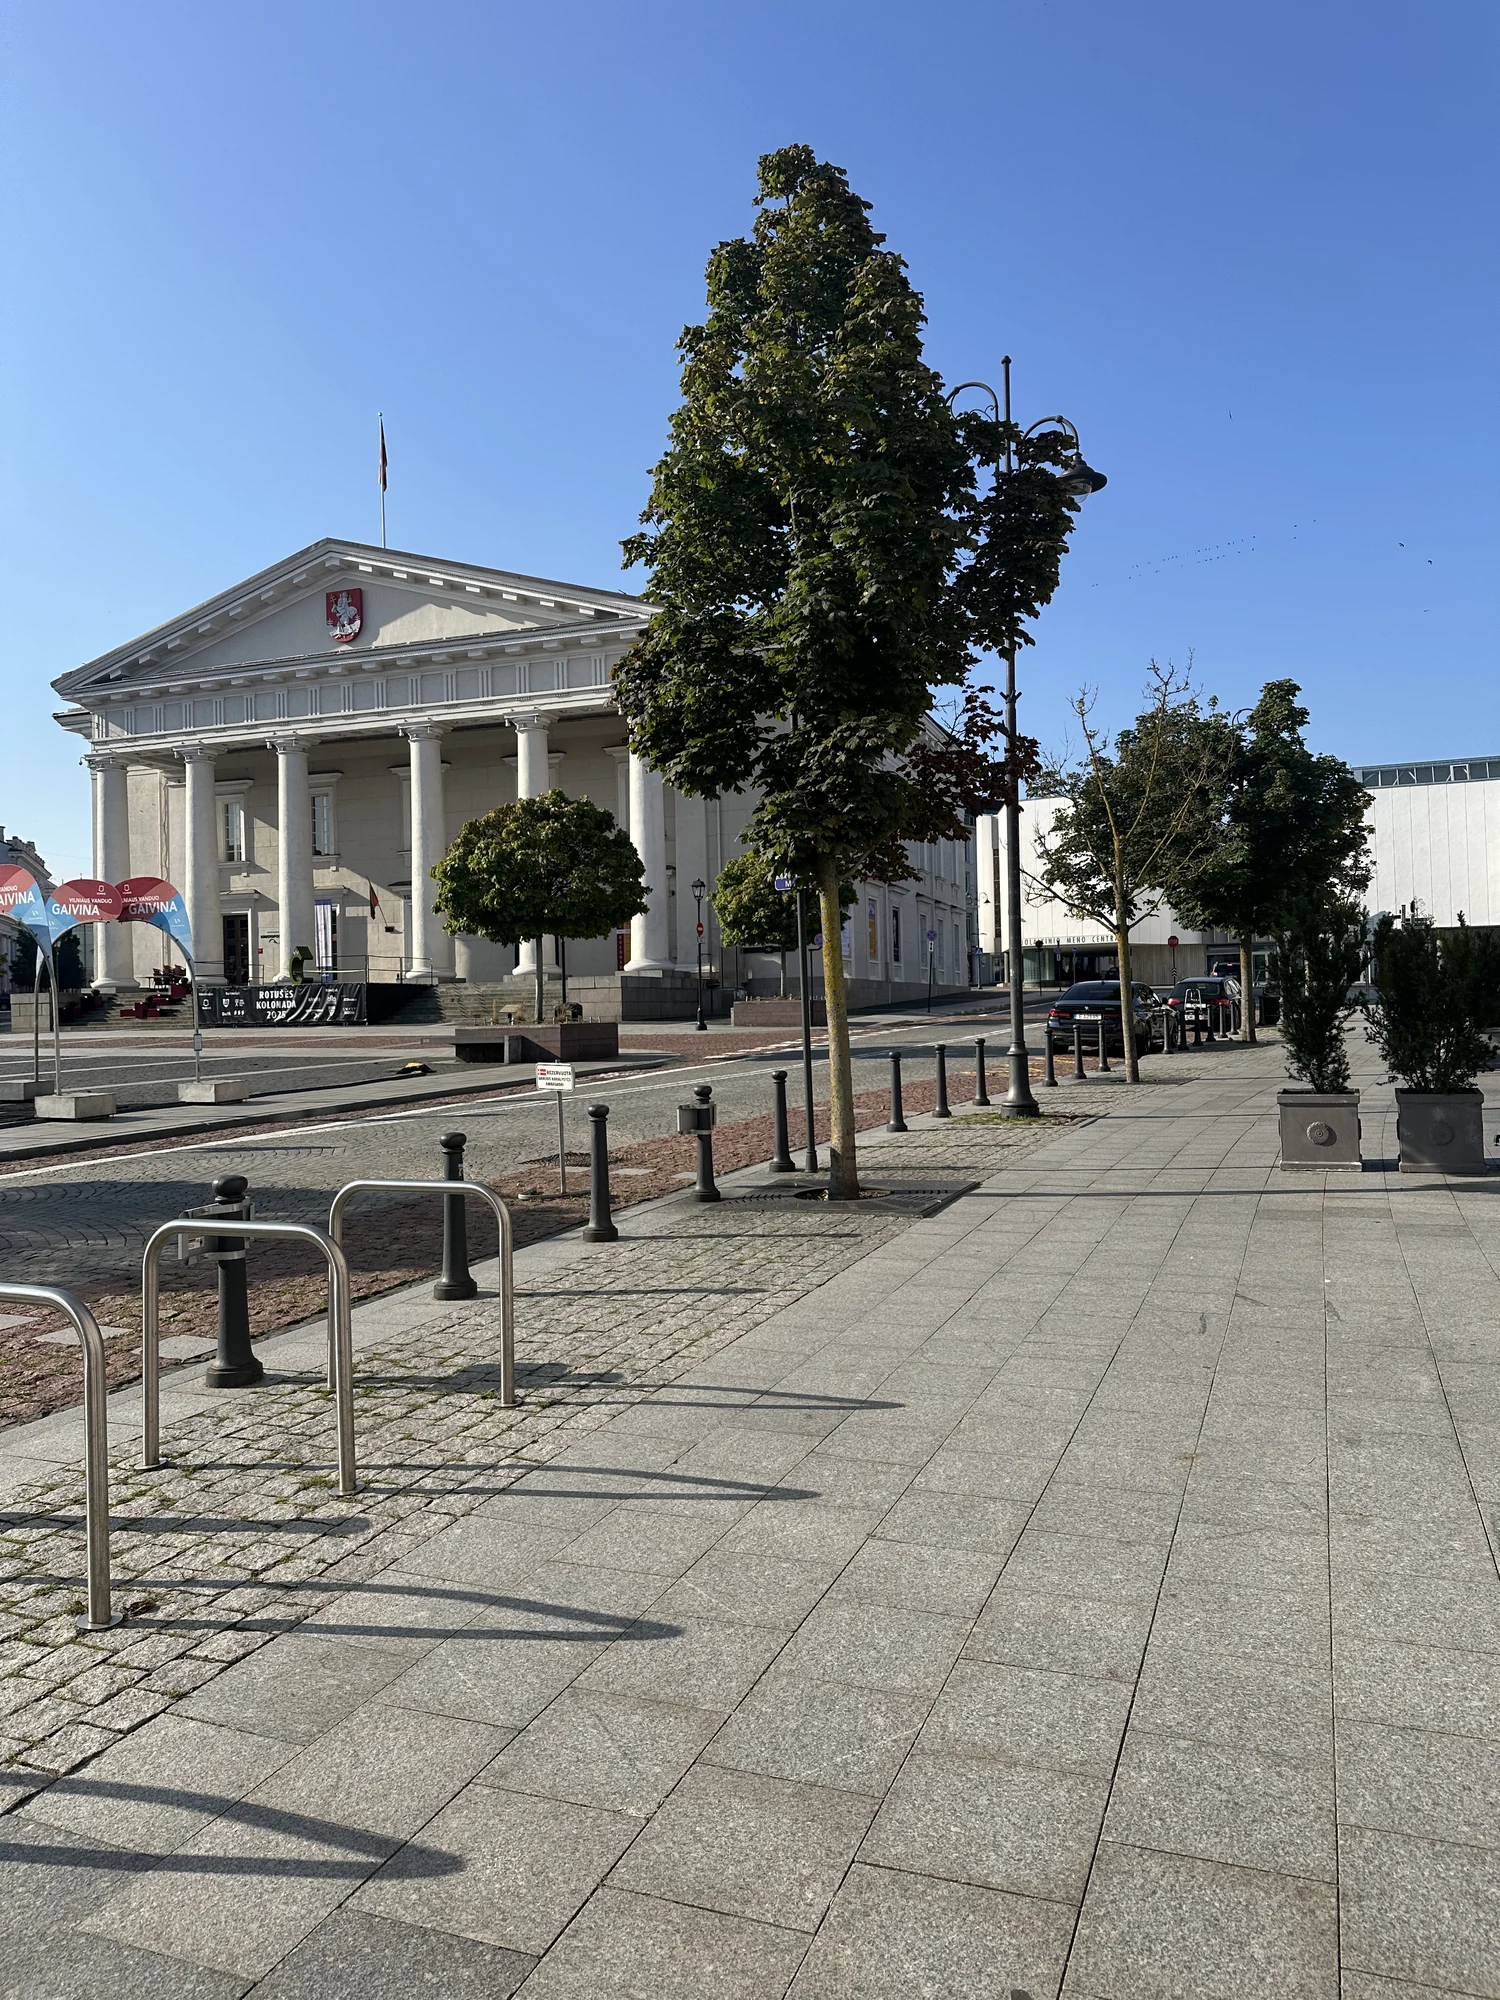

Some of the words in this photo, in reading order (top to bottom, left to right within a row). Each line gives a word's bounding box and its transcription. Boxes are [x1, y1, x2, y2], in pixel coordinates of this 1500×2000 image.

[0, 884, 18, 893] ANDUO
[0, 890, 36, 906] AIVINA
[51, 903, 100, 916] GAIVINA
[128, 900, 178, 915] GAIVINA
[1092, 935, 1118, 943] CENTR
[256, 999, 297, 1010] KOLONADA
[266, 1010, 287, 1020] 2025
